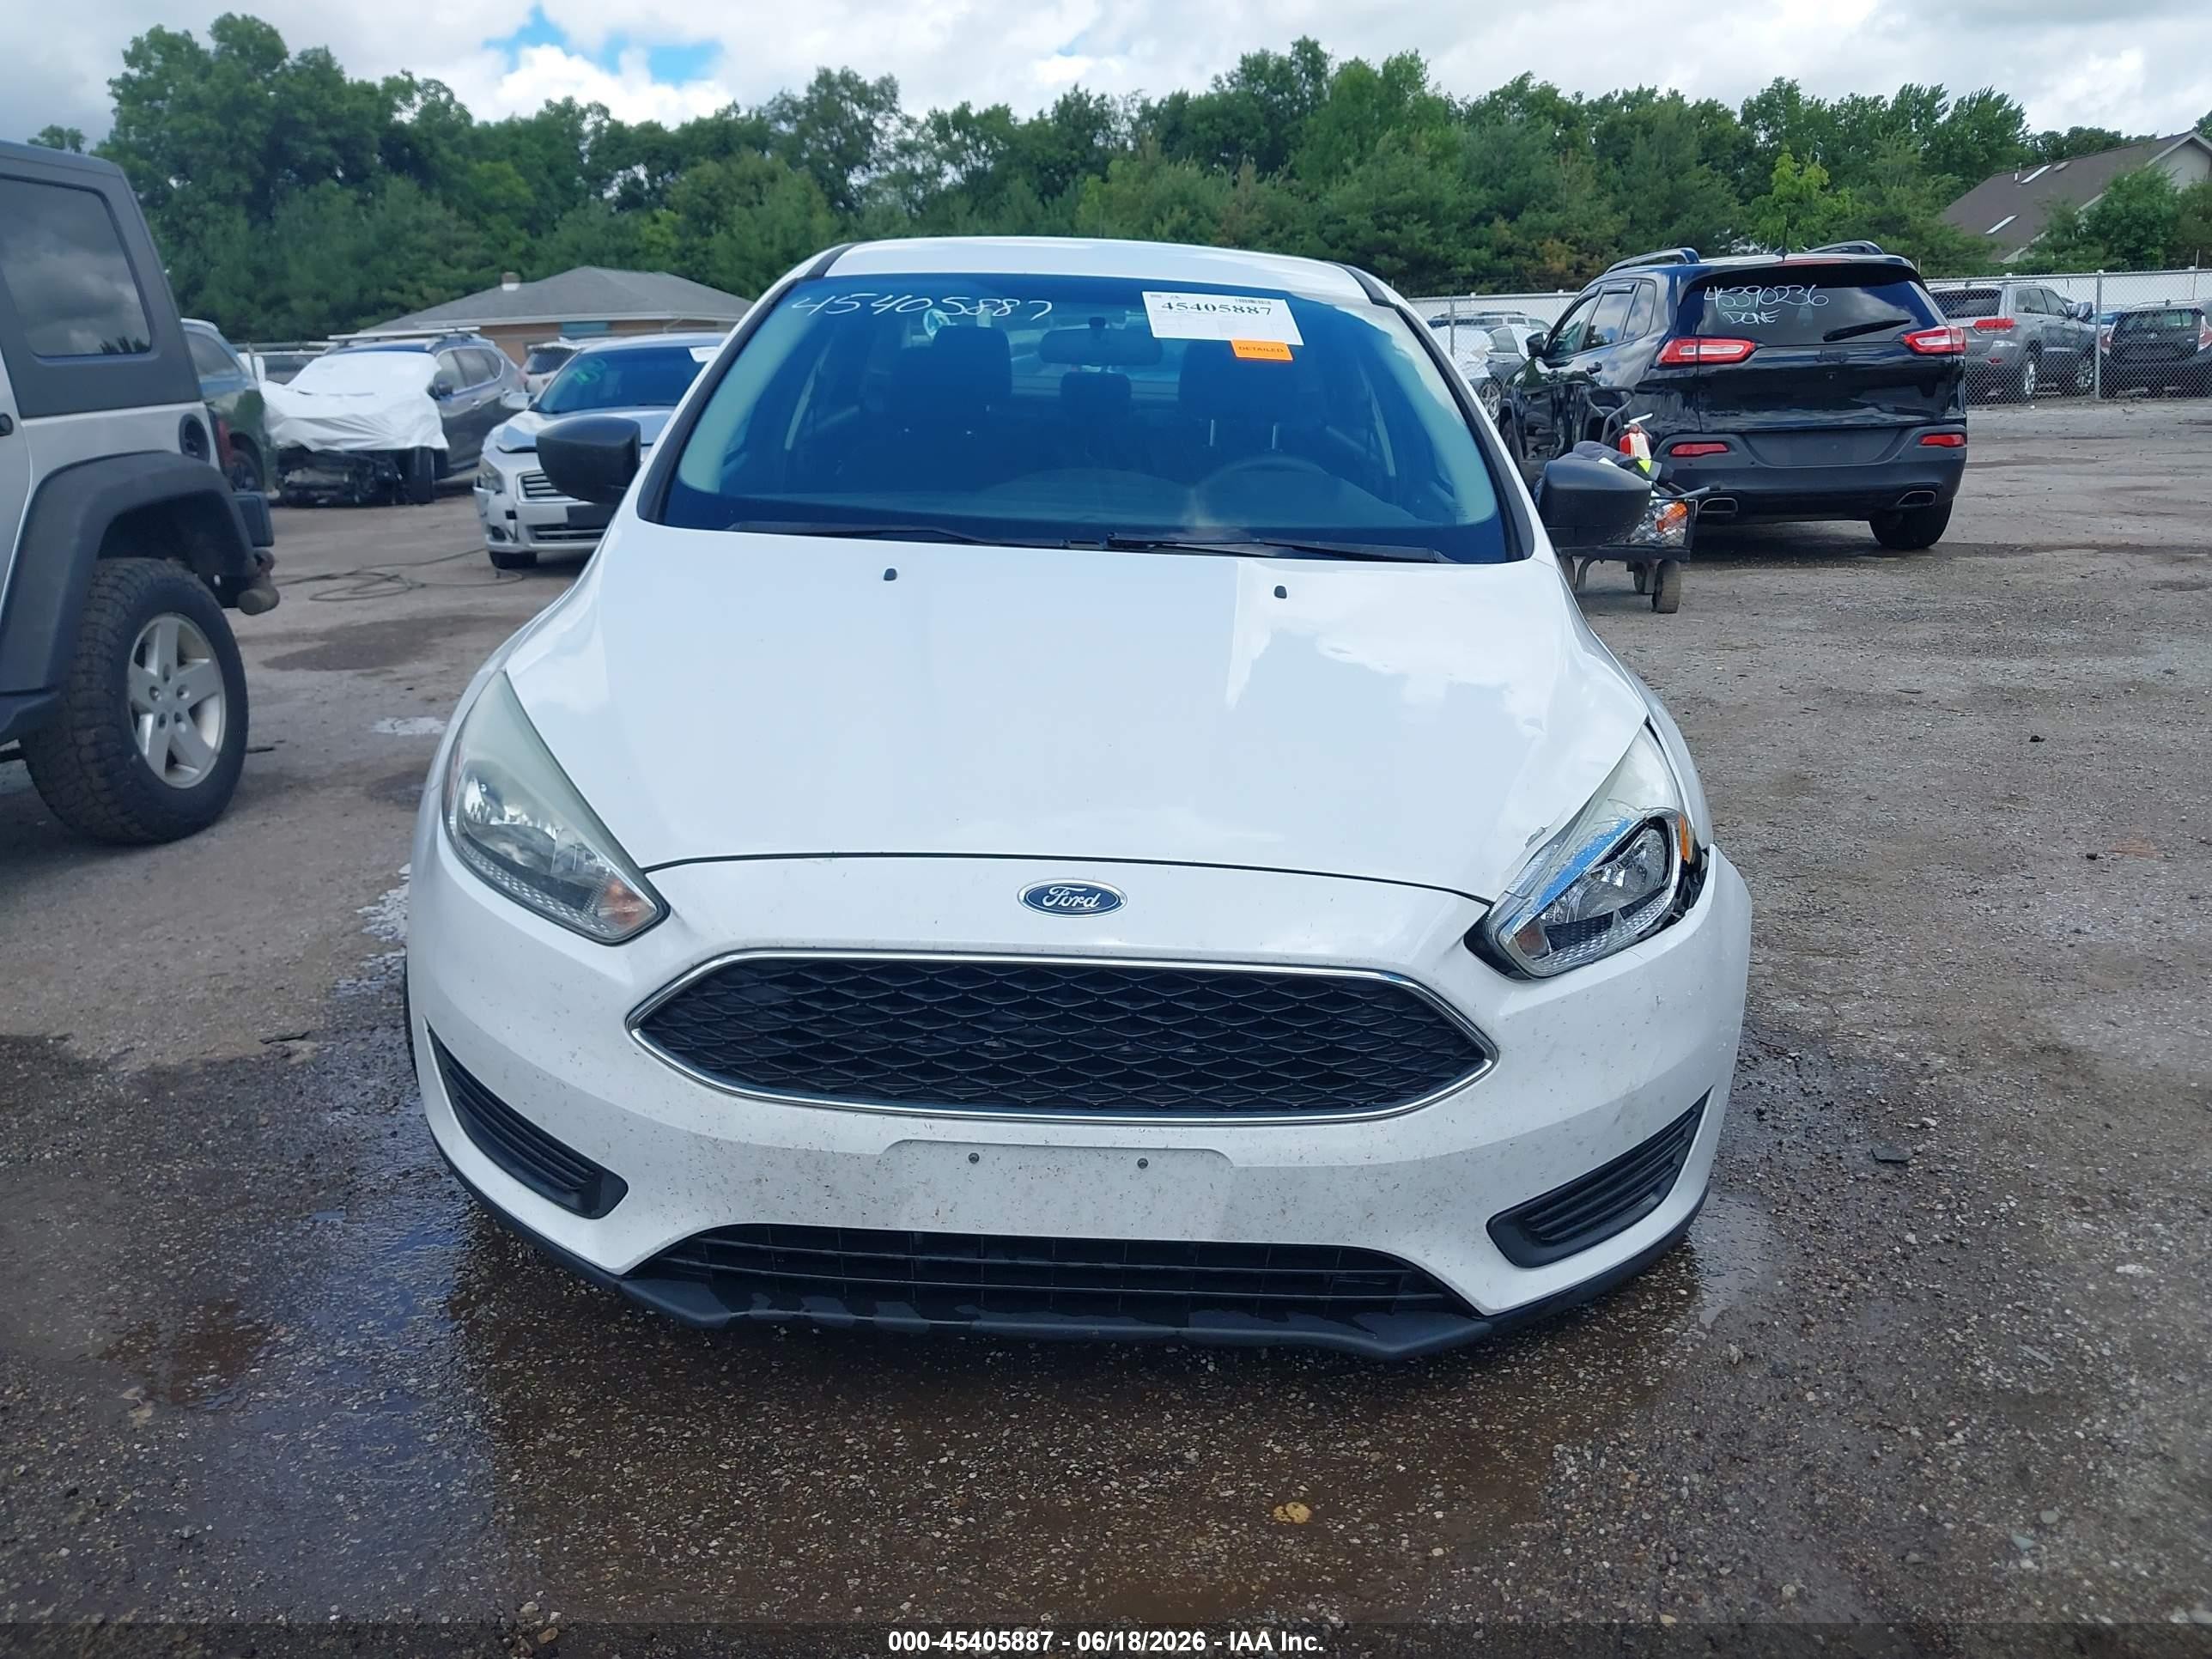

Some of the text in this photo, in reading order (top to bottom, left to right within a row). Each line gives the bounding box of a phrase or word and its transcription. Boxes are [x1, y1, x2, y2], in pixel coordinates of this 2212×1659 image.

[792, 293, 1052, 321] 45405887
[1704, 284, 1829, 308] 45390236
[1161, 301, 1272, 316] 45405887
[1723, 309, 1781, 325] DONE
[1042, 885, 1102, 908] Ford
